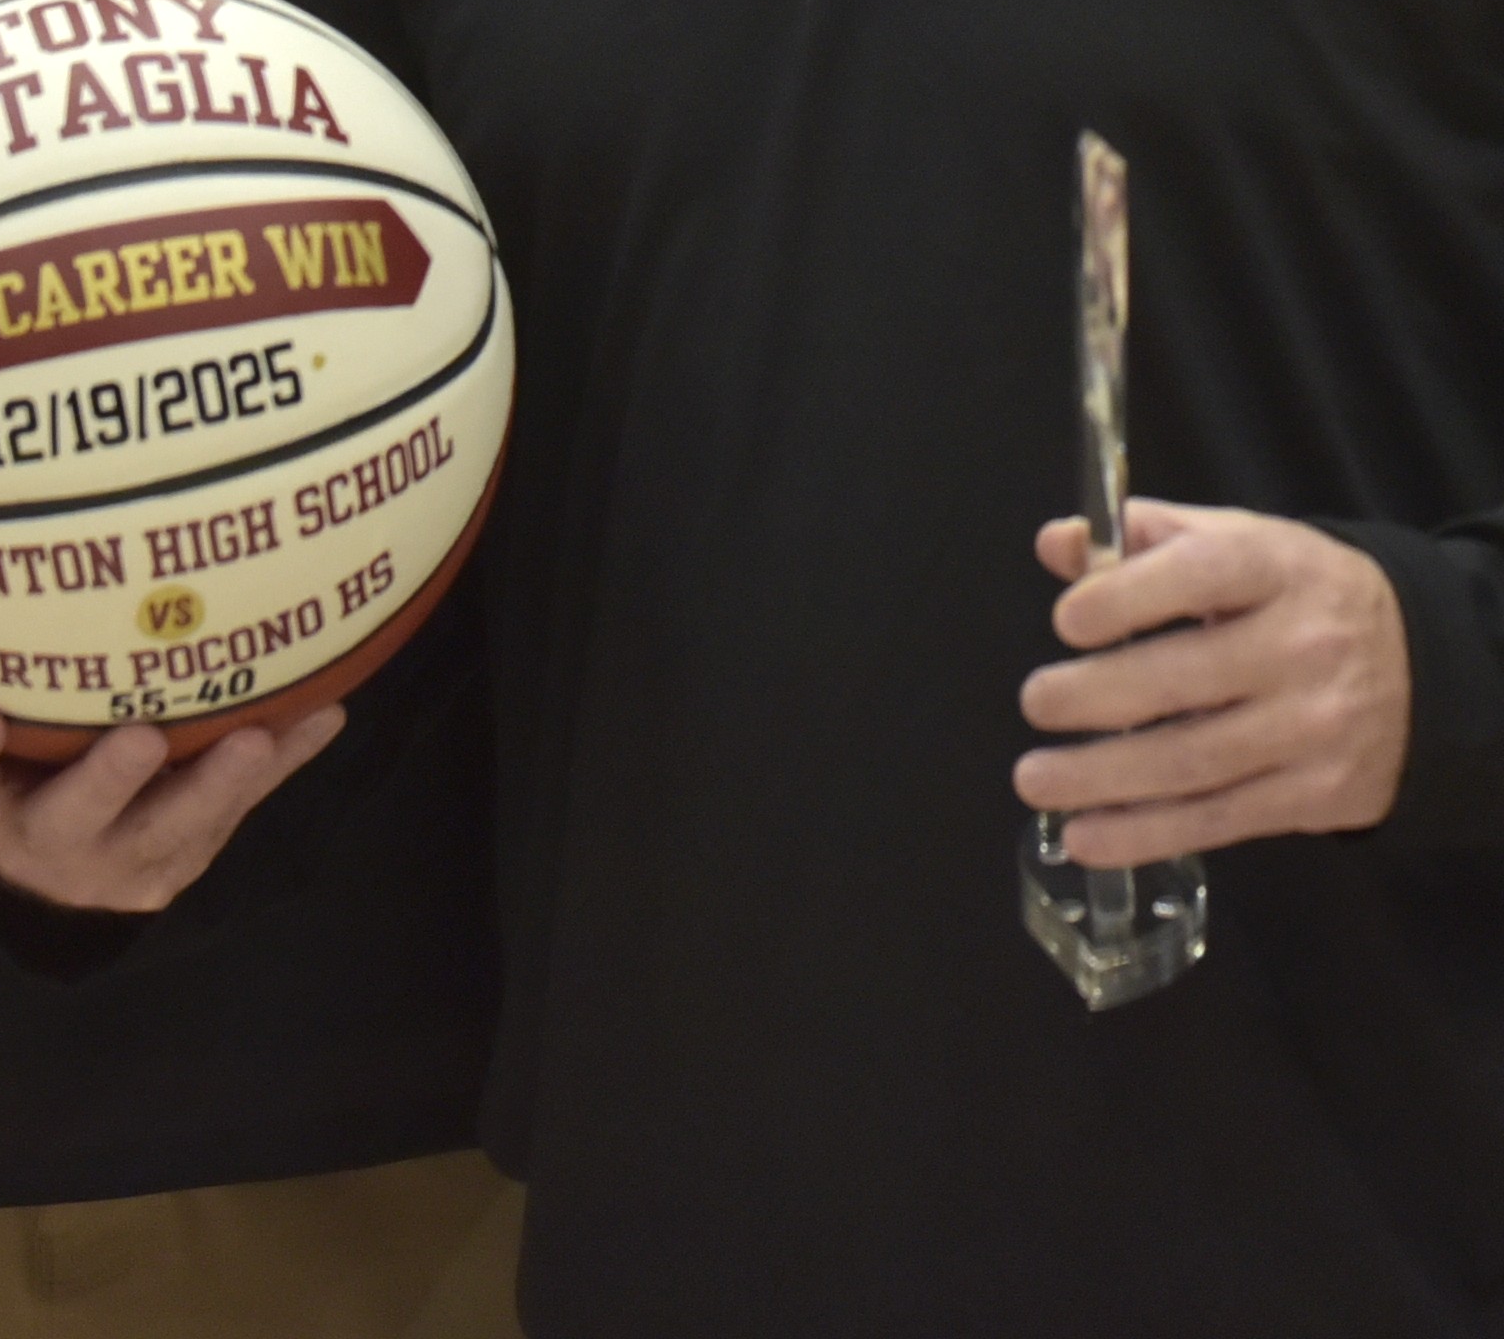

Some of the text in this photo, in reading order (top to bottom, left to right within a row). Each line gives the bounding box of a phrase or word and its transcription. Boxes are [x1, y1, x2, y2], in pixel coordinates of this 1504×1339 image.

[265, 222, 388, 290] WIN
[145, 498, 281, 578] HIGH
[295, 417, 454, 539] SCHOOL
[130, 600, 323, 688] POCONO
[337, 552, 395, 619] HS
[147, 595, 194, 631] VS
[108, 667, 256, 721] 55-40
